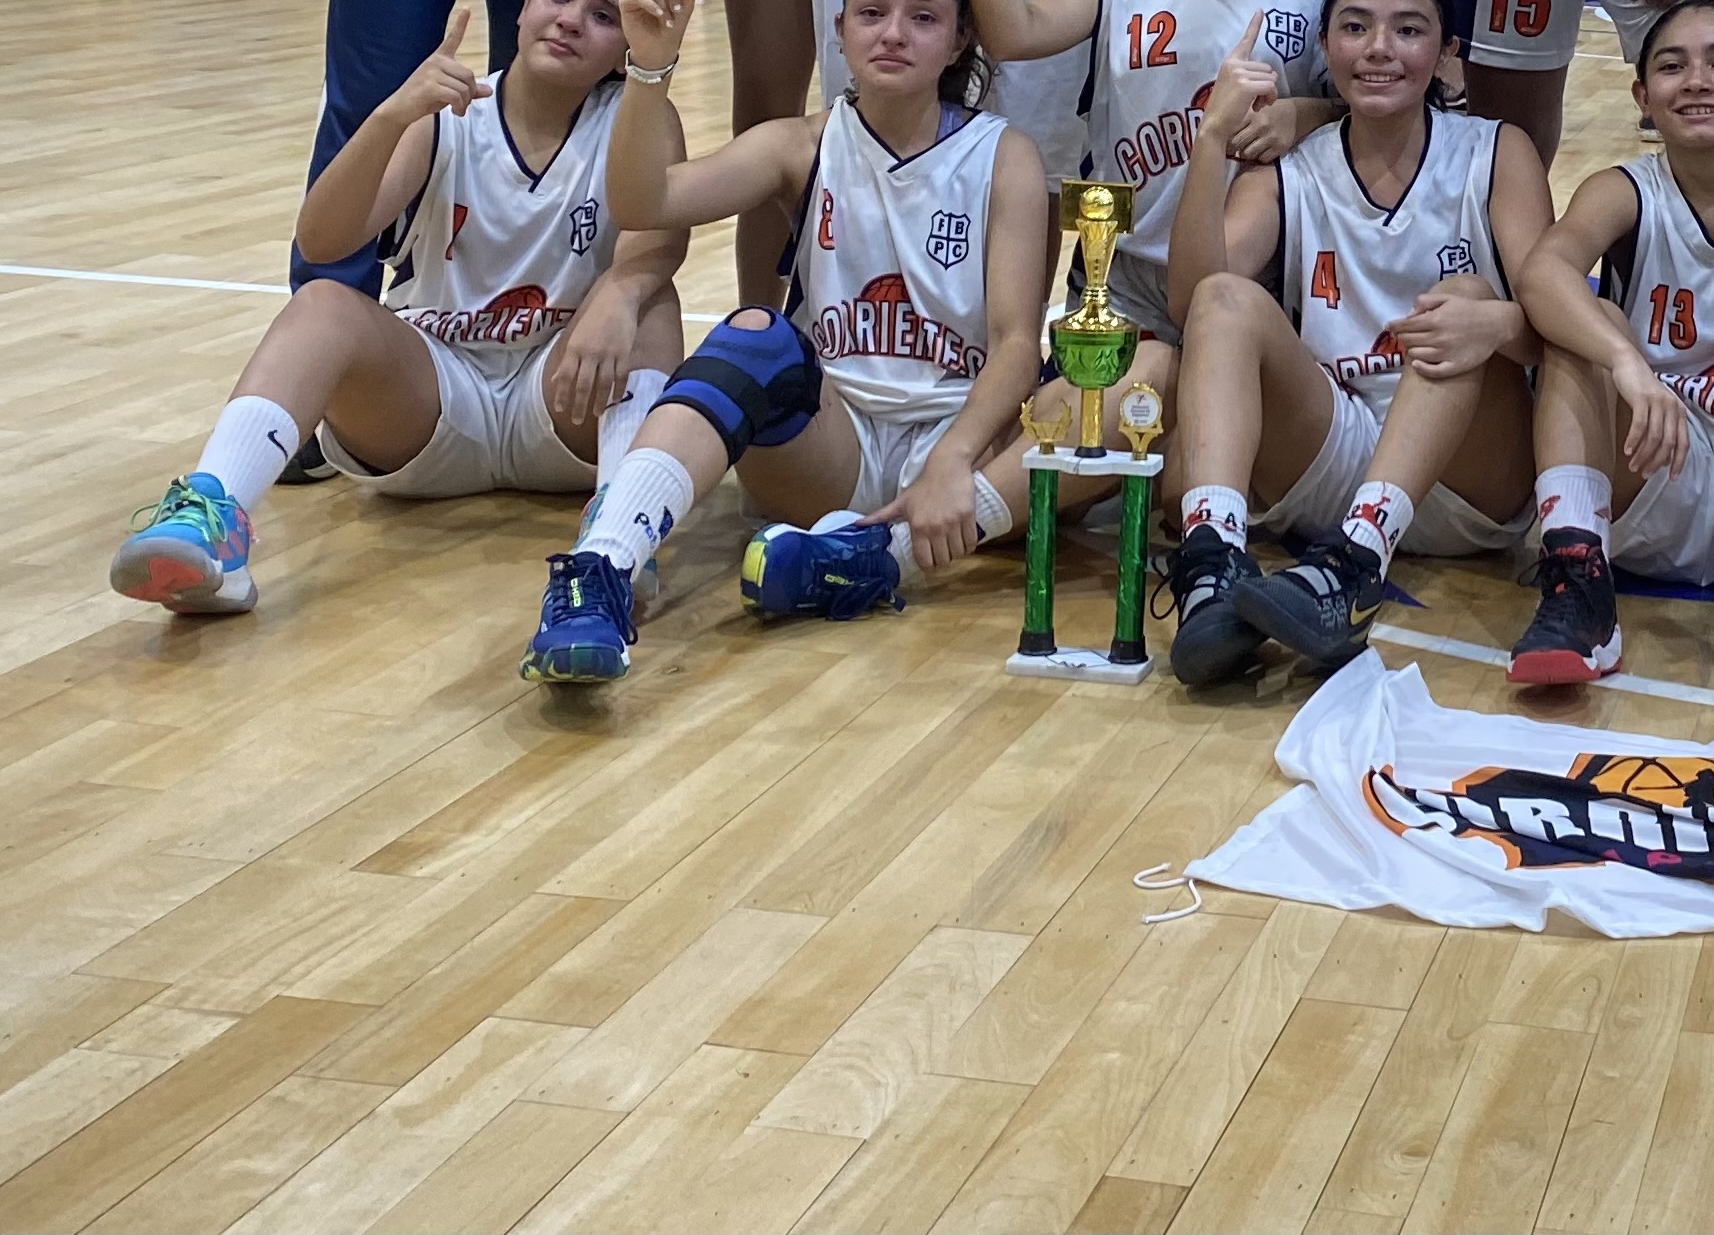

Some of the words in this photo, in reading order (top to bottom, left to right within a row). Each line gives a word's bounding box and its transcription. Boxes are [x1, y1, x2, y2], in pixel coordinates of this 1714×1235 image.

[1126, 11, 1178, 70] 12
[1310, 251, 1341, 309] 4
[1647, 283, 1698, 351] 13
